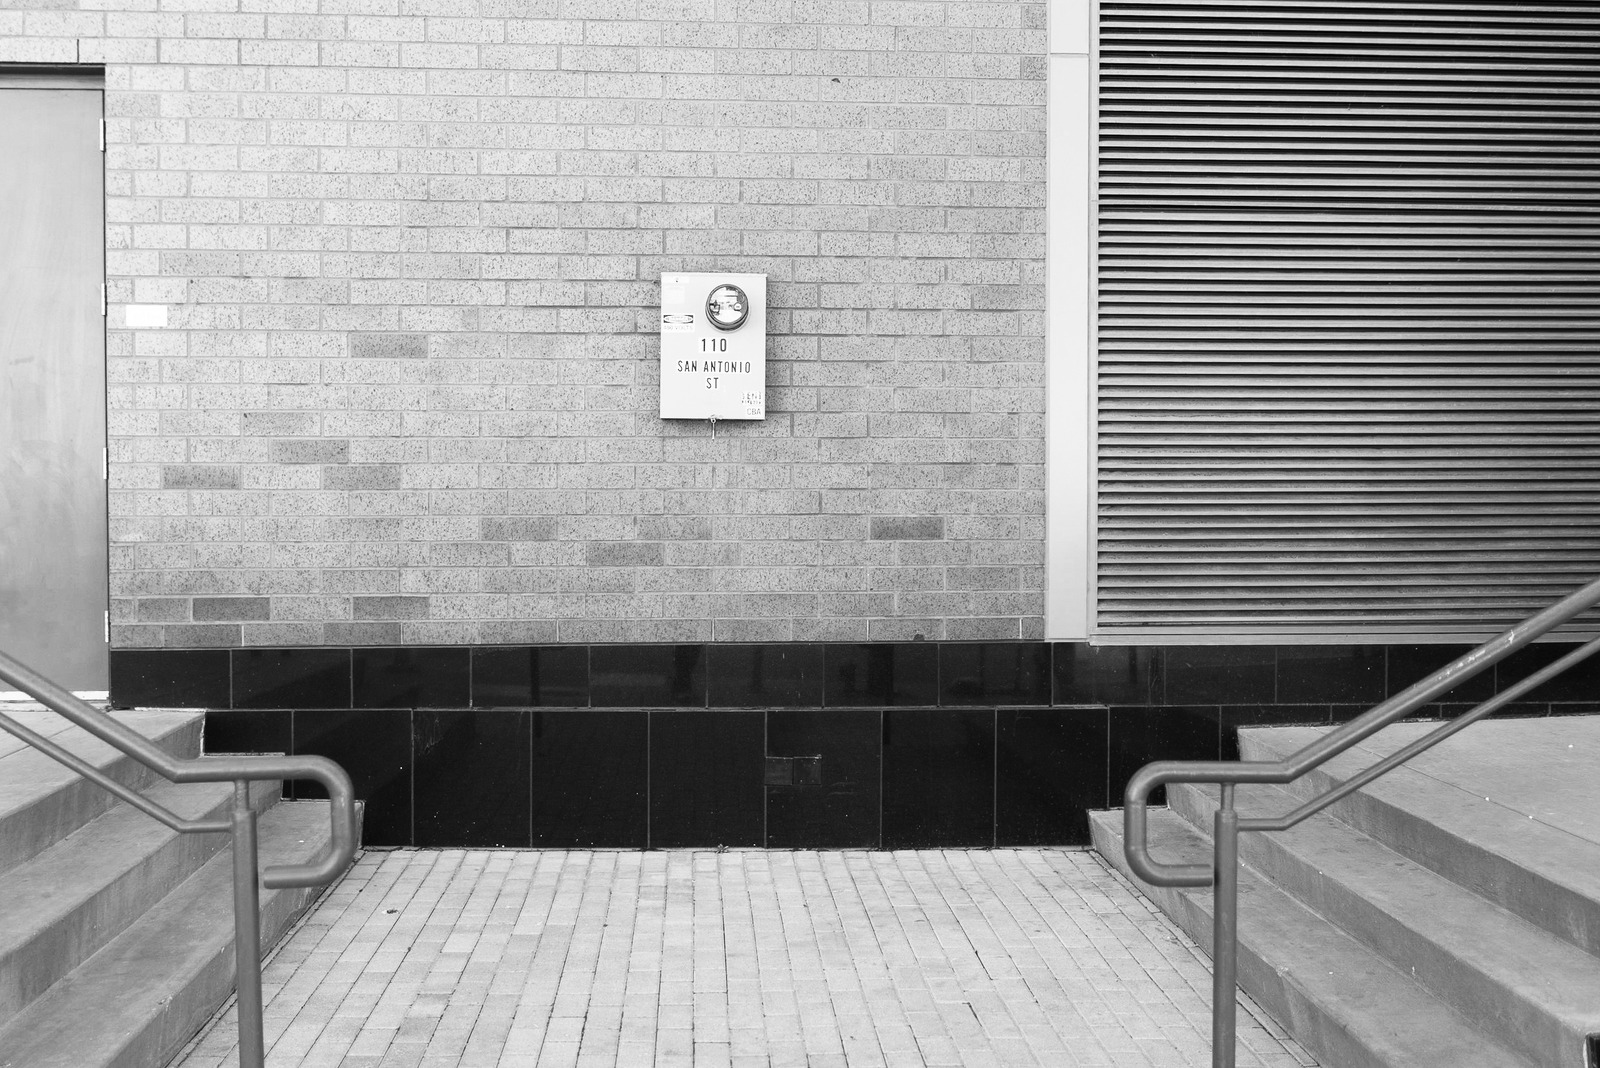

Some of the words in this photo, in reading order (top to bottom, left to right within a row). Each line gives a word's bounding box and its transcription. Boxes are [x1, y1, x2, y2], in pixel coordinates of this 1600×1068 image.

[701, 338, 728, 352] 110
[677, 360, 698, 373] SAN
[703, 360, 751, 374] ANTONIO
[706, 377, 719, 389] ST
